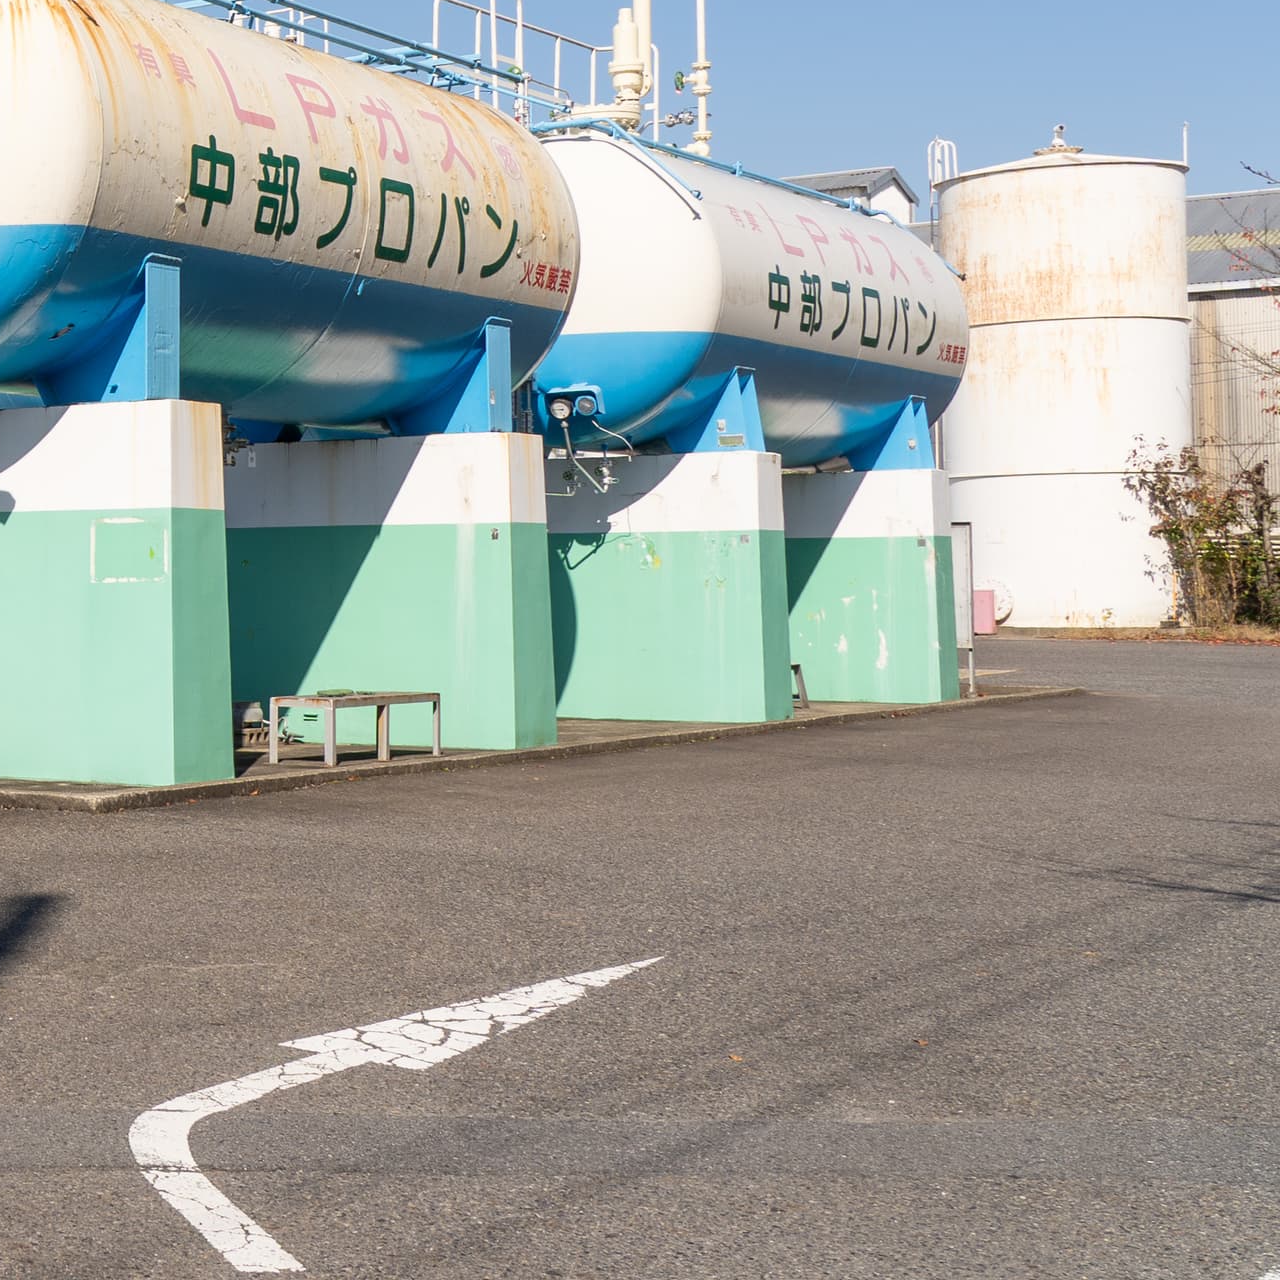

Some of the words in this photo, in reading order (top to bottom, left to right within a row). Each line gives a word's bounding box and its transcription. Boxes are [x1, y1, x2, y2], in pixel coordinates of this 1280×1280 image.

[189, 134, 518, 280] 中部プロパン
[520, 260, 572, 294] 火気厳禁
[768, 264, 937, 356] 中部プロパン
